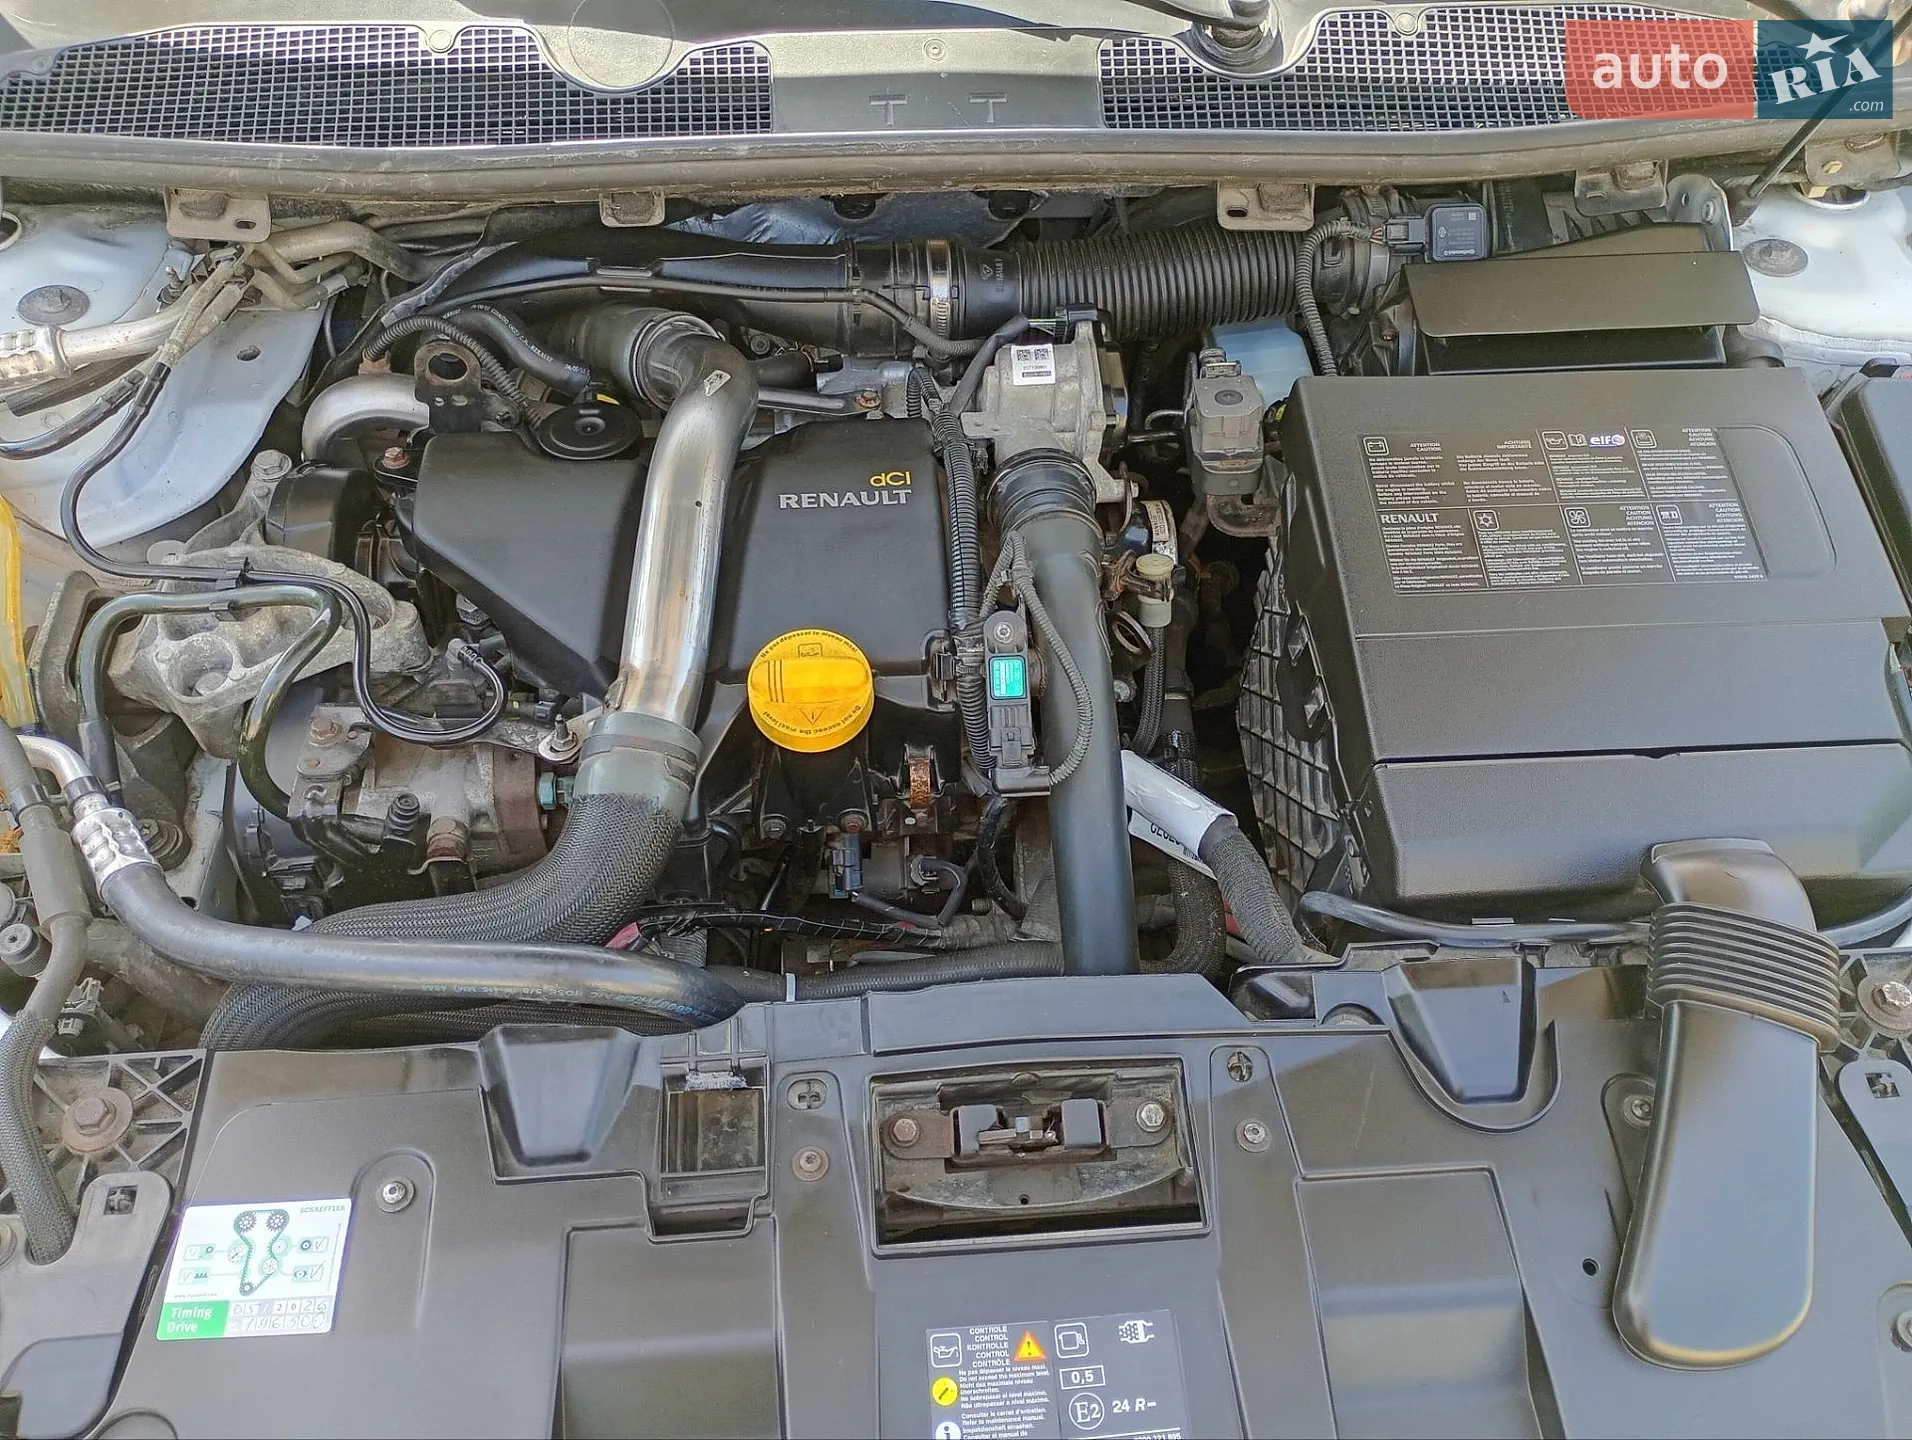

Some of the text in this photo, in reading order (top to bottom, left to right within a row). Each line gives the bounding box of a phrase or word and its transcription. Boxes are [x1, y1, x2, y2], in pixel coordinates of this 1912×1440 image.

[1590, 435, 1612, 445] elf
[778, 489, 912, 509] RENAULT
[1380, 512, 1439, 524] RENAULT
[171, 1306, 213, 1320] Timing
[166, 1321, 198, 1333] Drive
[975, 1333, 1009, 1343] CONTROL
[966, 1341, 1009, 1351] KONTROLLE
[976, 1350, 1010, 1359] CONTROL
[1070, 1369, 1094, 1385] 0,5
[1112, 1398, 1131, 1413] 24
[1074, 1401, 1101, 1423] E2
